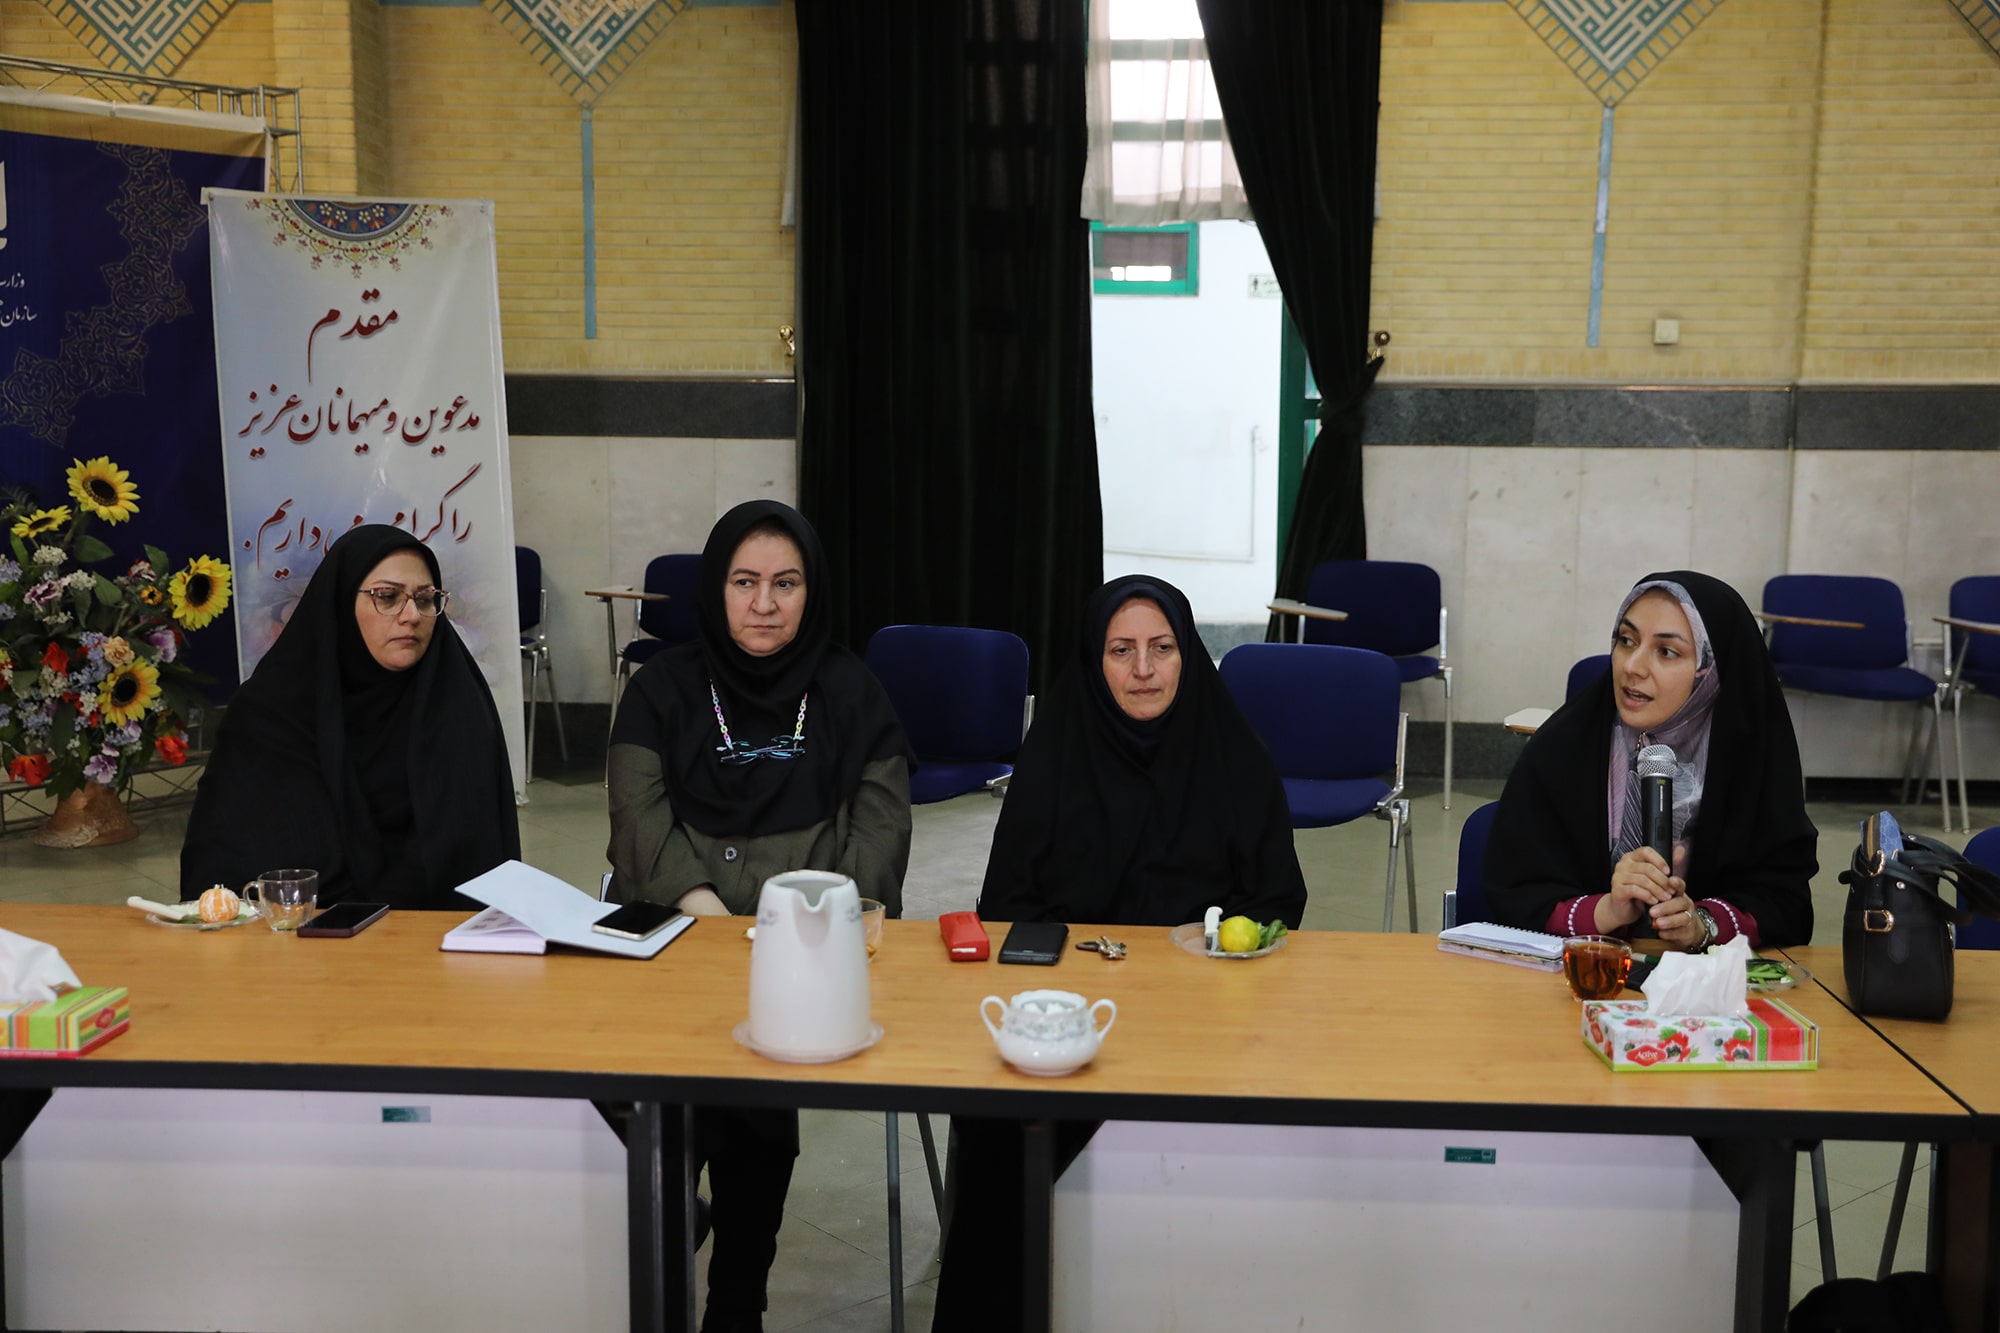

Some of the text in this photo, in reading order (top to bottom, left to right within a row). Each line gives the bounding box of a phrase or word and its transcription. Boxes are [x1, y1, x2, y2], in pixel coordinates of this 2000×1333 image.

[0, 305, 38, 327] سازمان
[308, 287, 399, 384] مقدم
[238, 383, 303, 458] عزیز
[287, 386, 390, 454] میهمانان
[401, 394, 481, 456] مدعوین
[392, 462, 482, 543] گرام
[452, 508, 472, 542] را
